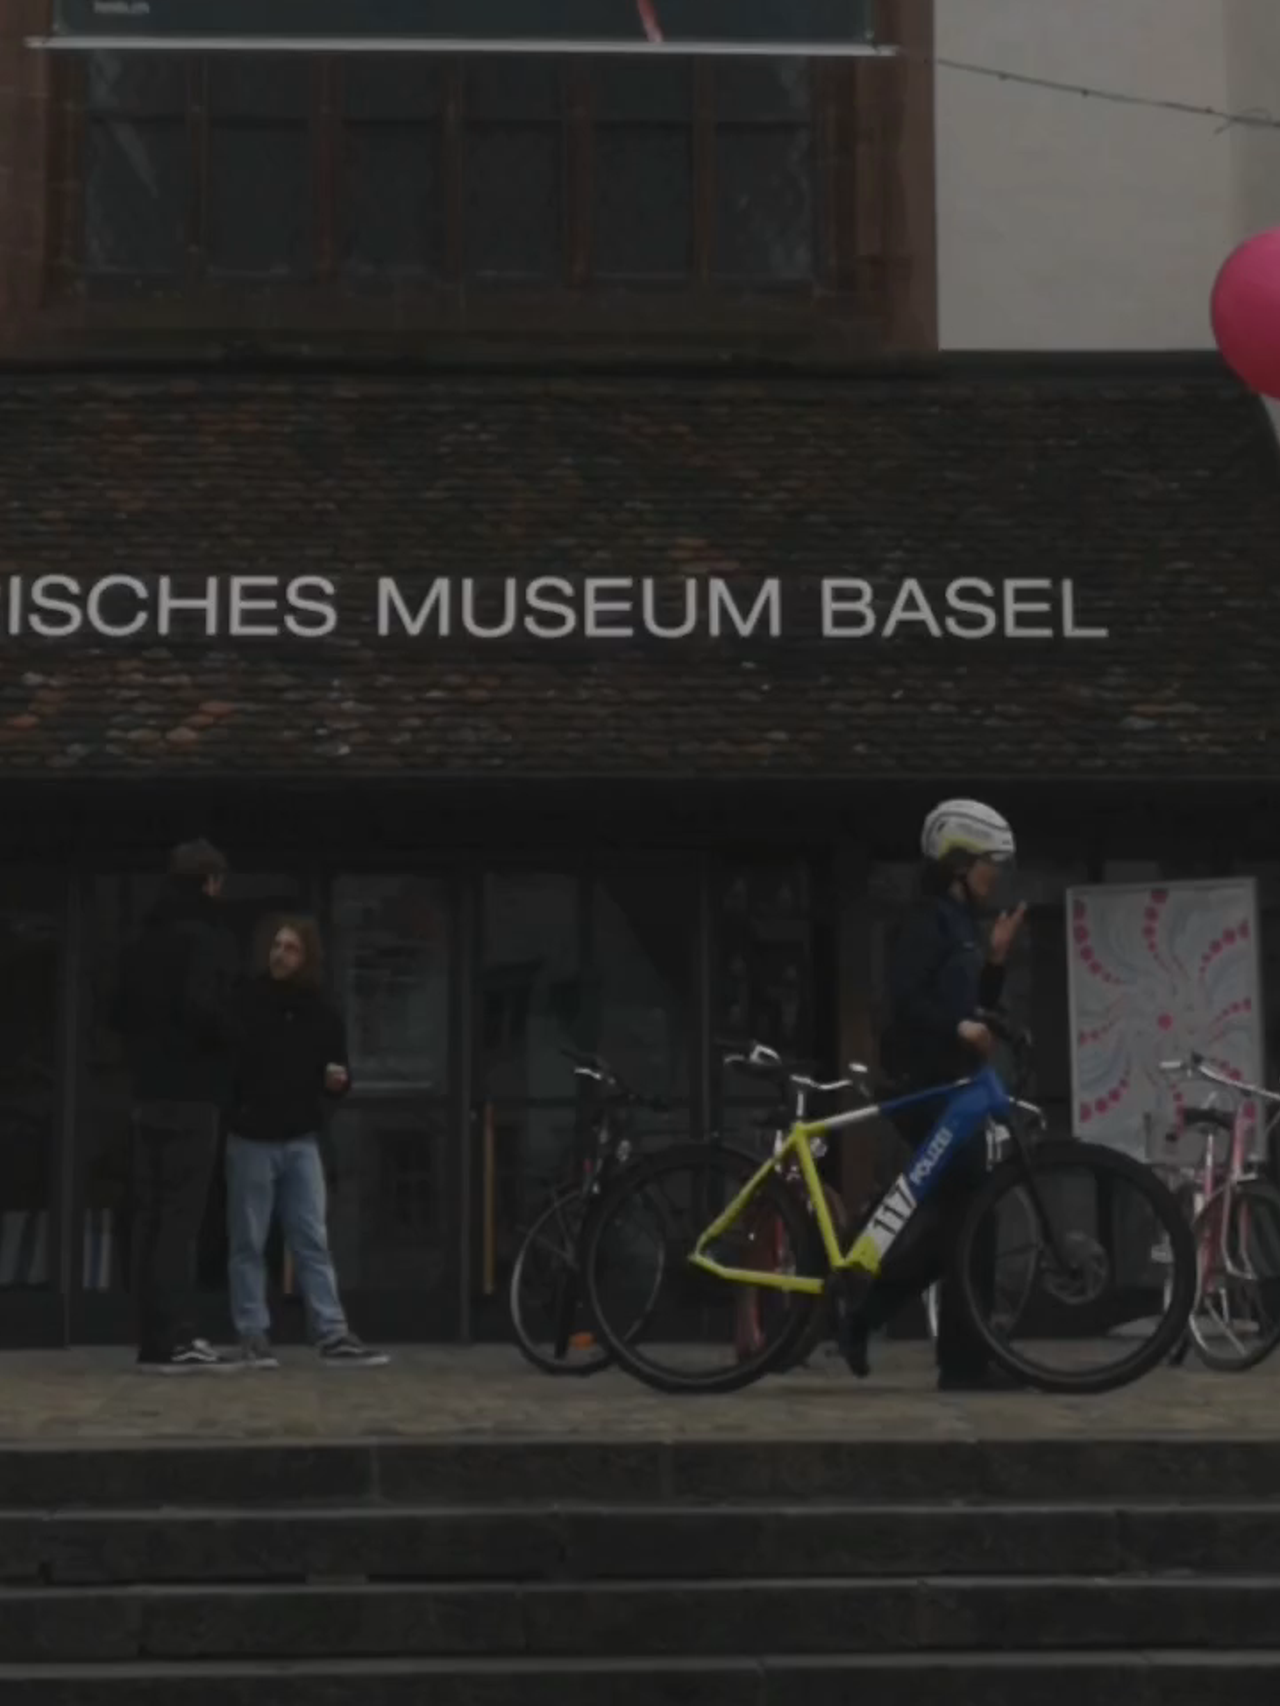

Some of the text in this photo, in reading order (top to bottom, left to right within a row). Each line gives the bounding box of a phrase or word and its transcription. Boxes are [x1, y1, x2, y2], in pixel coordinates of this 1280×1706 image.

[377, 576, 782, 639] MUSEUM
[821, 577, 1109, 639] BASEL
[908, 1126, 955, 1187] POLIZEI
